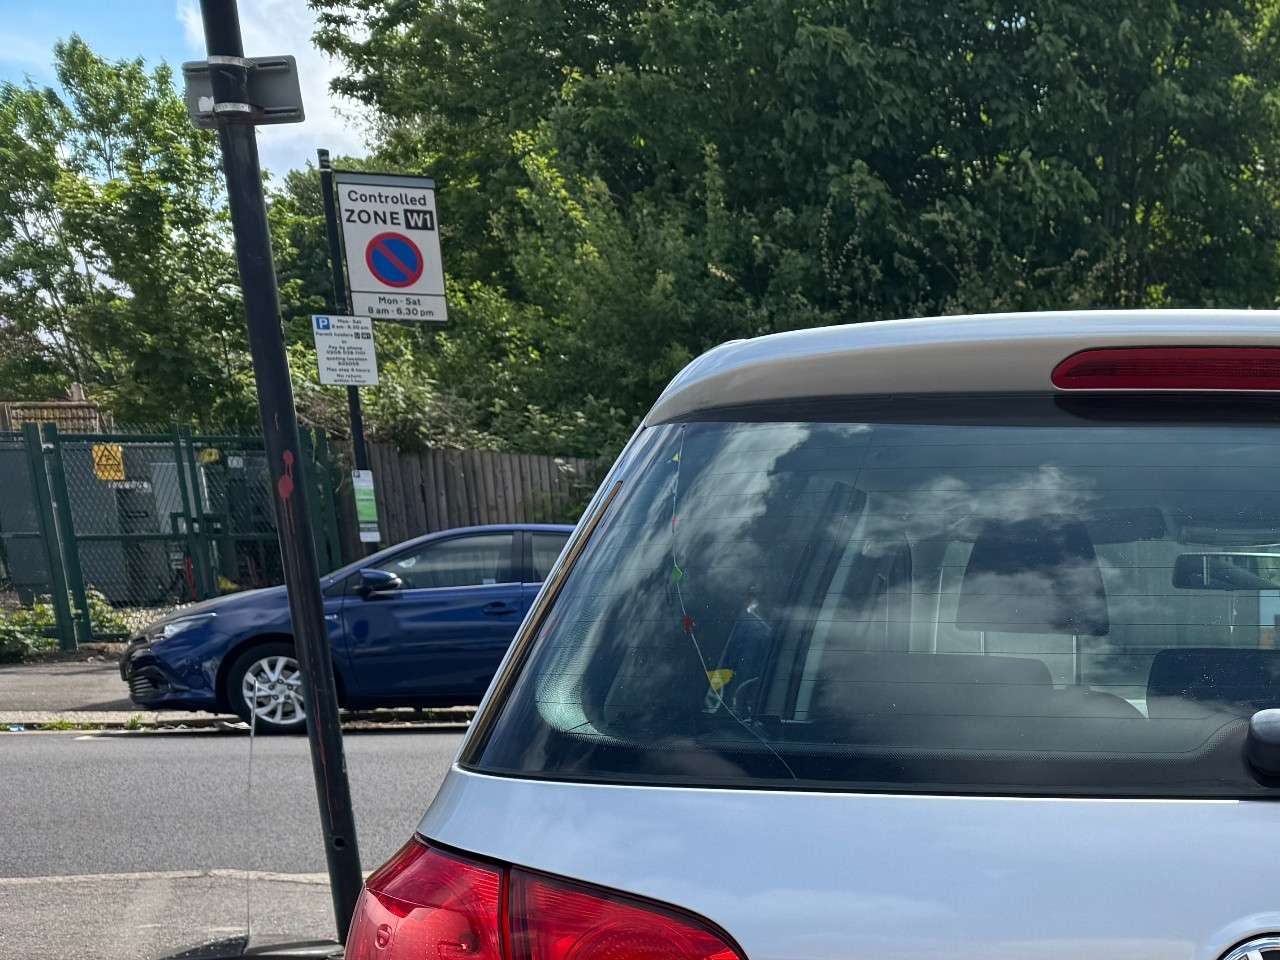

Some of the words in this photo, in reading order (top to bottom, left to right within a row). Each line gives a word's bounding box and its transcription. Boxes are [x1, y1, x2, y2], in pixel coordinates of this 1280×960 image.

[347, 190, 427, 206] Controlled
[344, 209, 401, 225] ZONE
[405, 211, 433, 229] W1
[378, 296, 398, 305] Mon
[405, 297, 421, 306] Sat
[396, 308, 418, 316] 6.30
[319, 317, 328, 328] P
